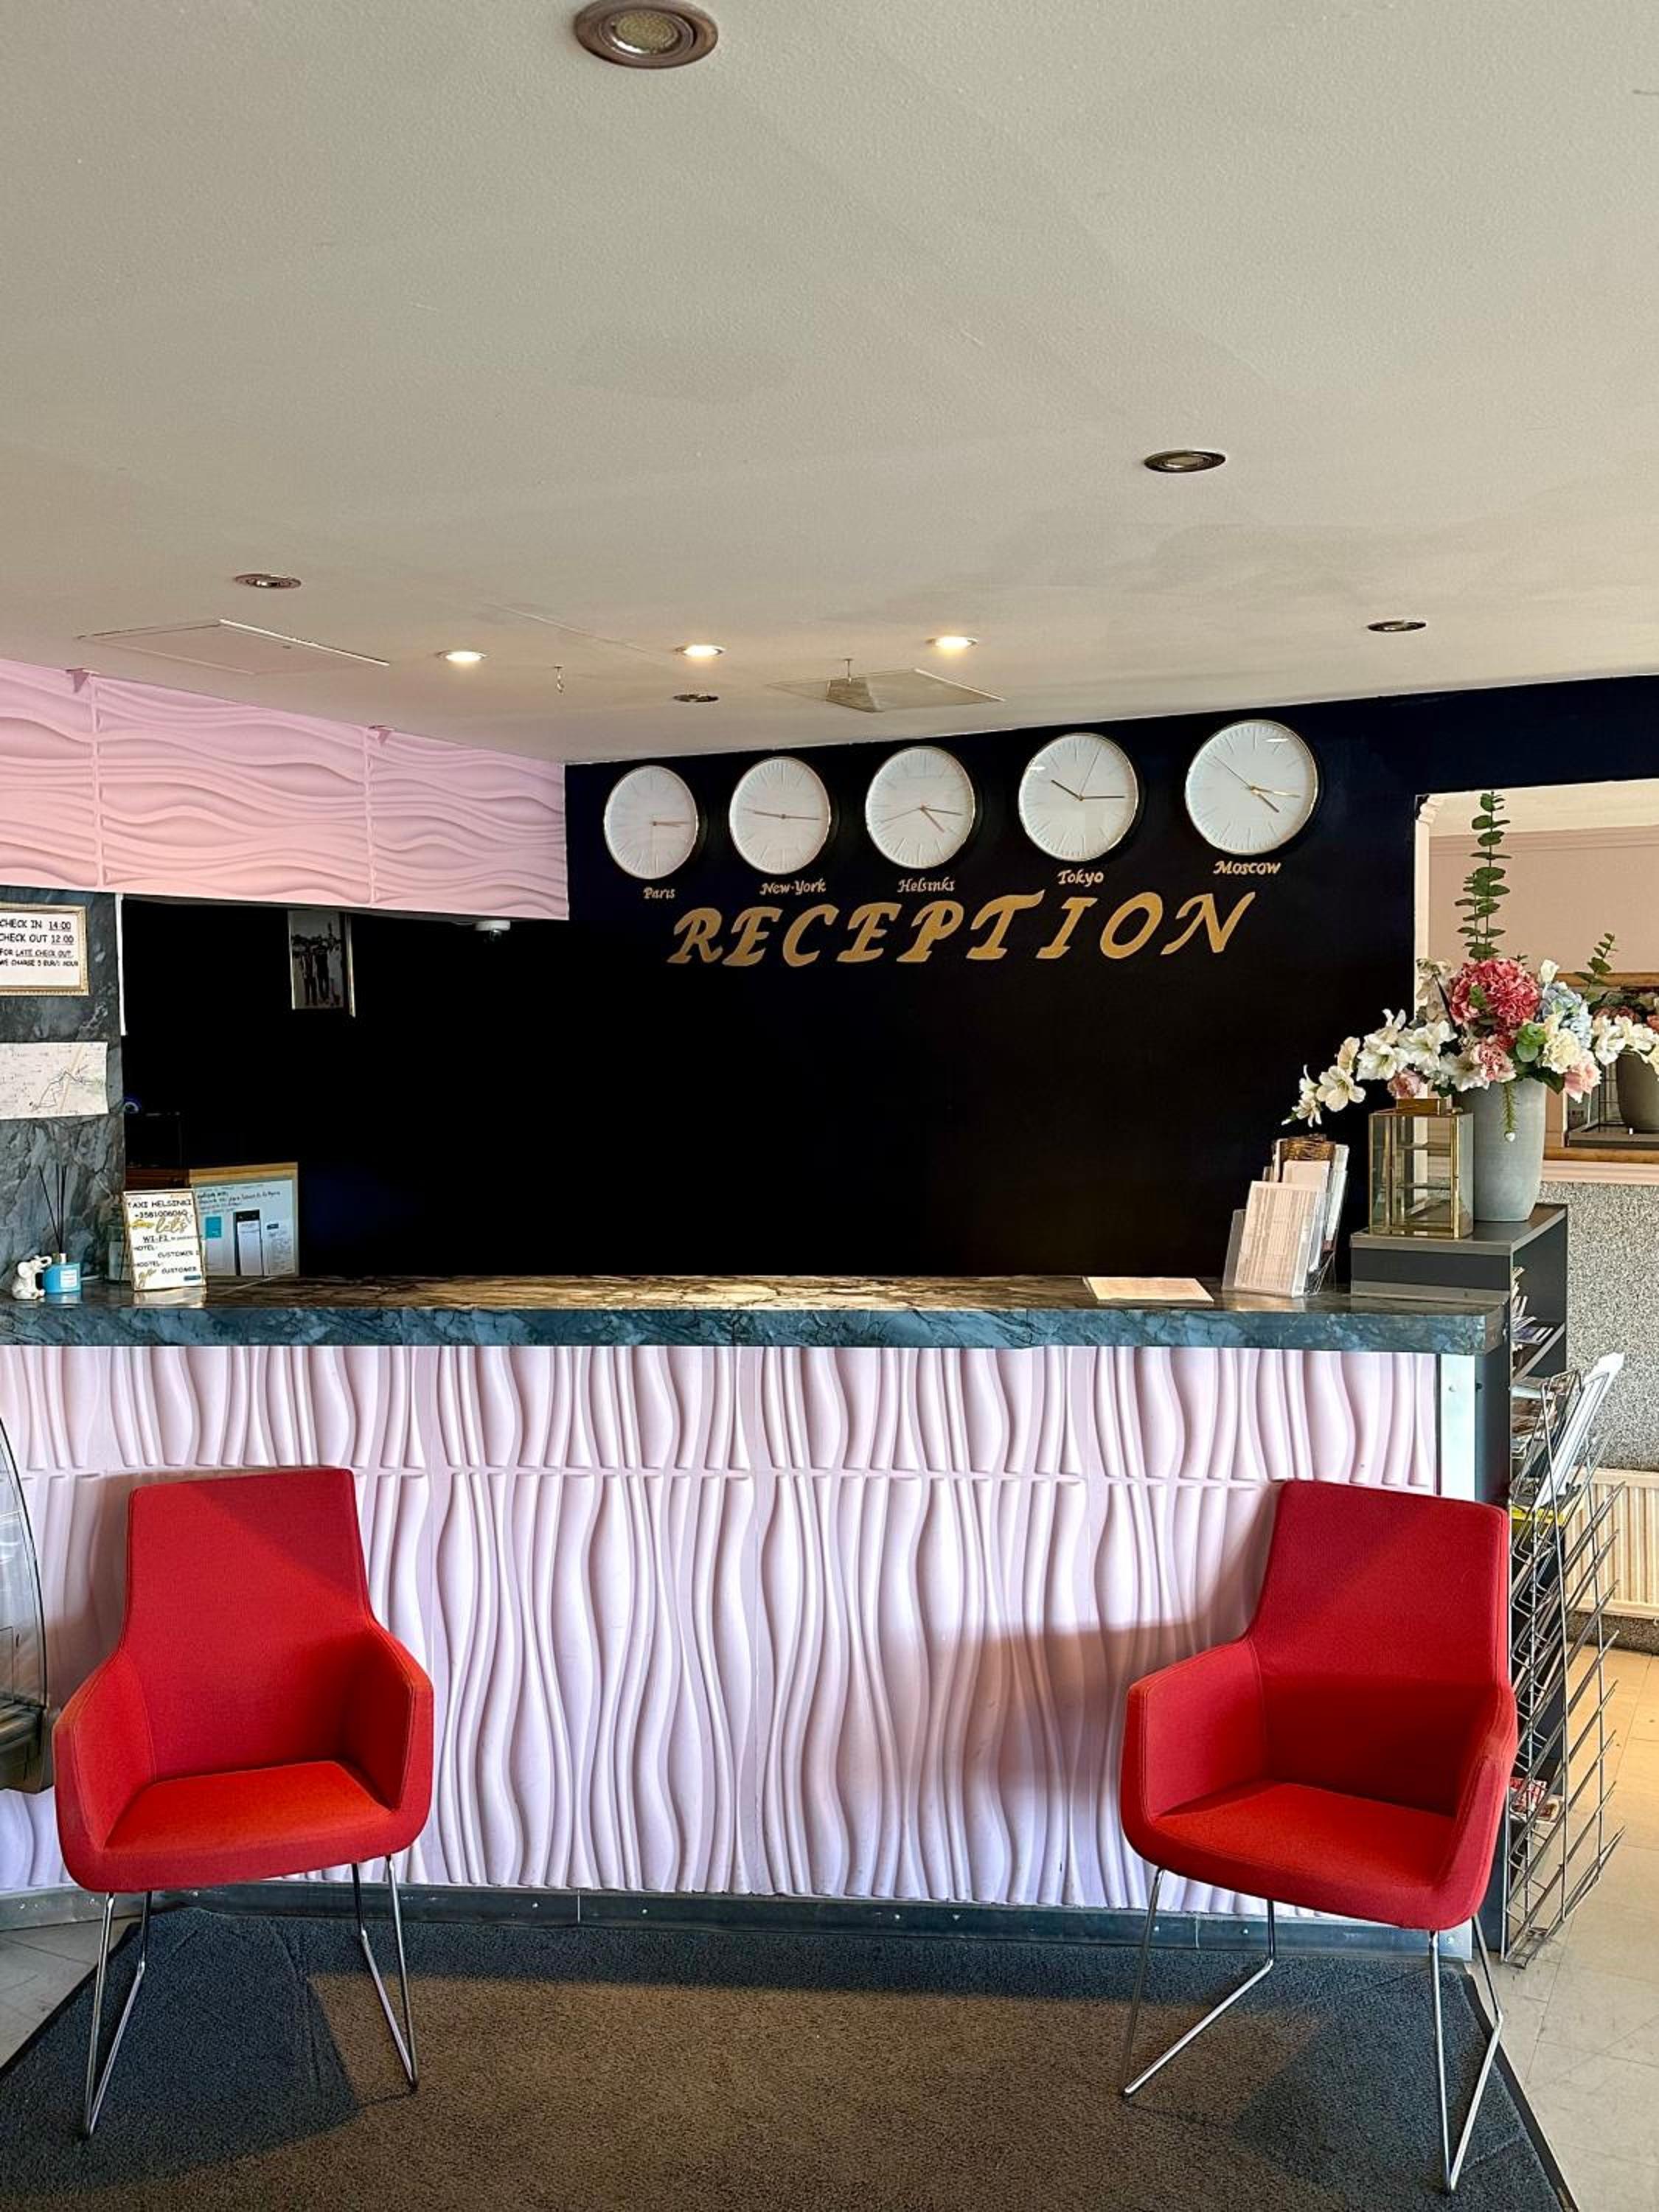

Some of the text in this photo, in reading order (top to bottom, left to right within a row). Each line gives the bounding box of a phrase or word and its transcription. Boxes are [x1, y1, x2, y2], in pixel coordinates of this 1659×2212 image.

[1213, 860, 1281, 876] Moscow
[897, 877, 956, 893] Helsinki
[1057, 868, 1105, 888] Tokyo
[643, 886, 675, 900] Paris
[0, 918, 27, 928] CHECK
[30, 919, 42, 928] IN
[667, 889, 1256, 967] RECEPTION
[0, 933, 74, 944] CHECK OUT 1200
[151, 1199, 192, 1208] HELSINKI
